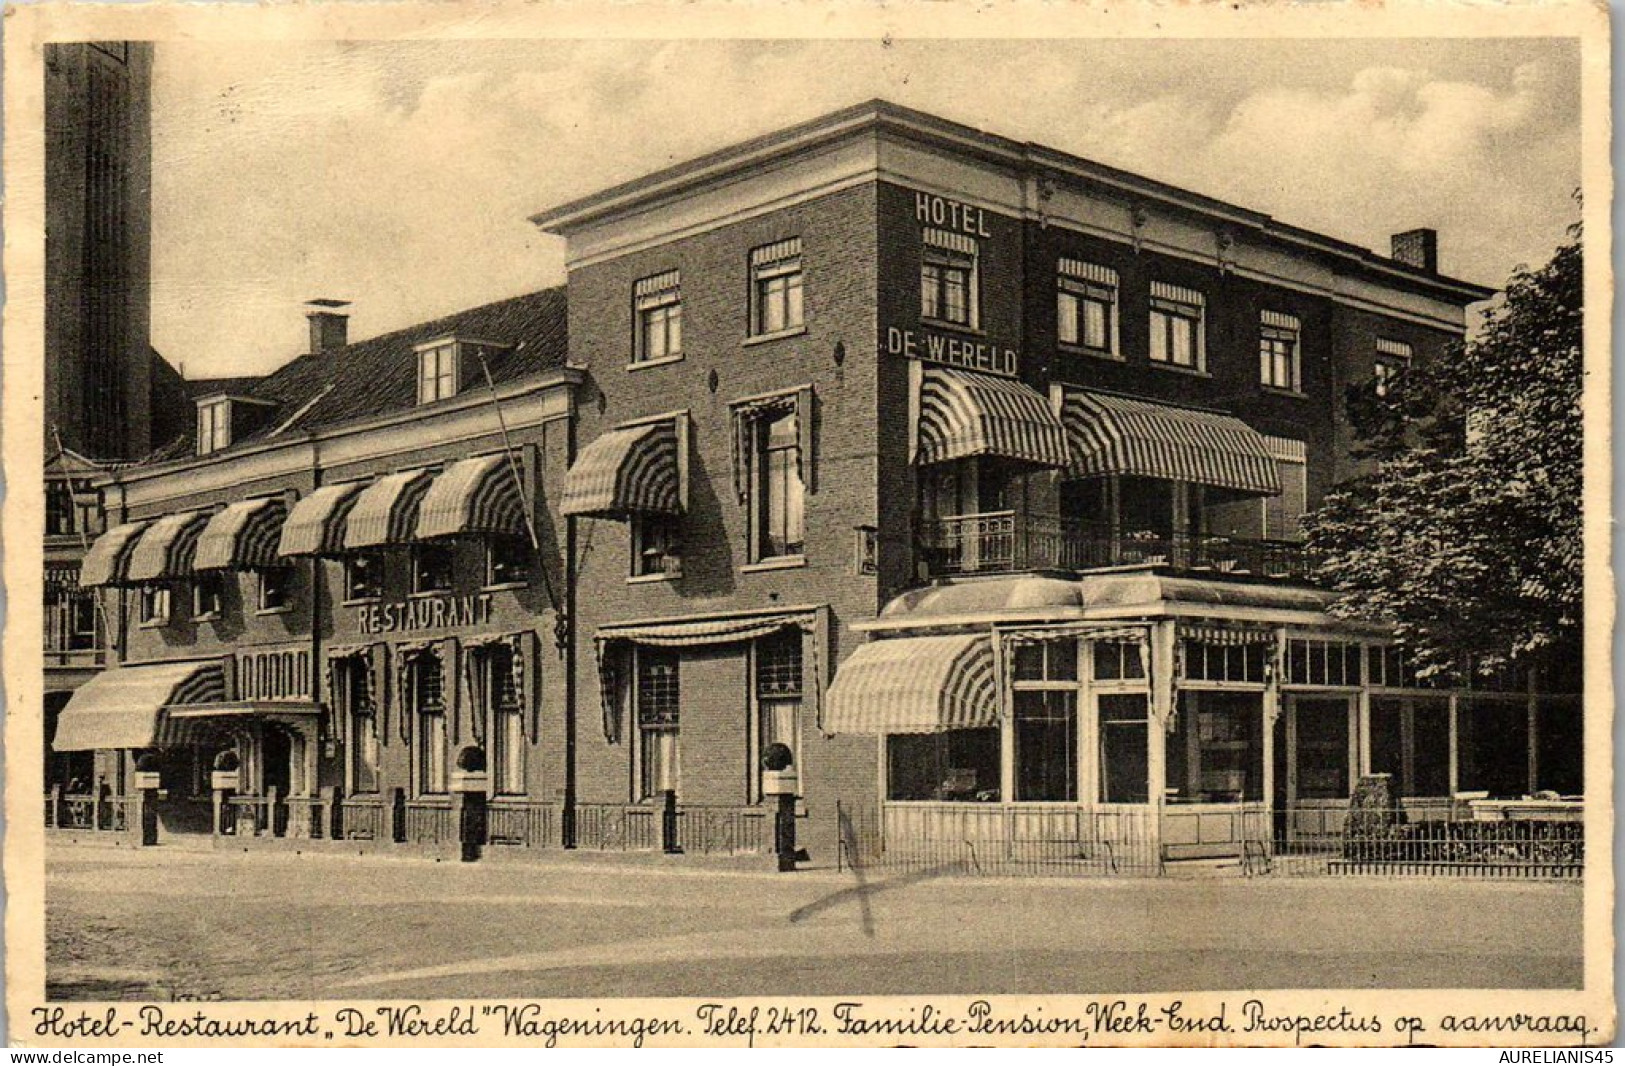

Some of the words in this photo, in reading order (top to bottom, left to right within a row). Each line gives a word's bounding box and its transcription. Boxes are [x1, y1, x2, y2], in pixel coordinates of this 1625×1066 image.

[915, 192, 991, 239] HOTEL
[927, 333, 1018, 376] WERELD
[358, 593, 491, 634] RESTAURANT
